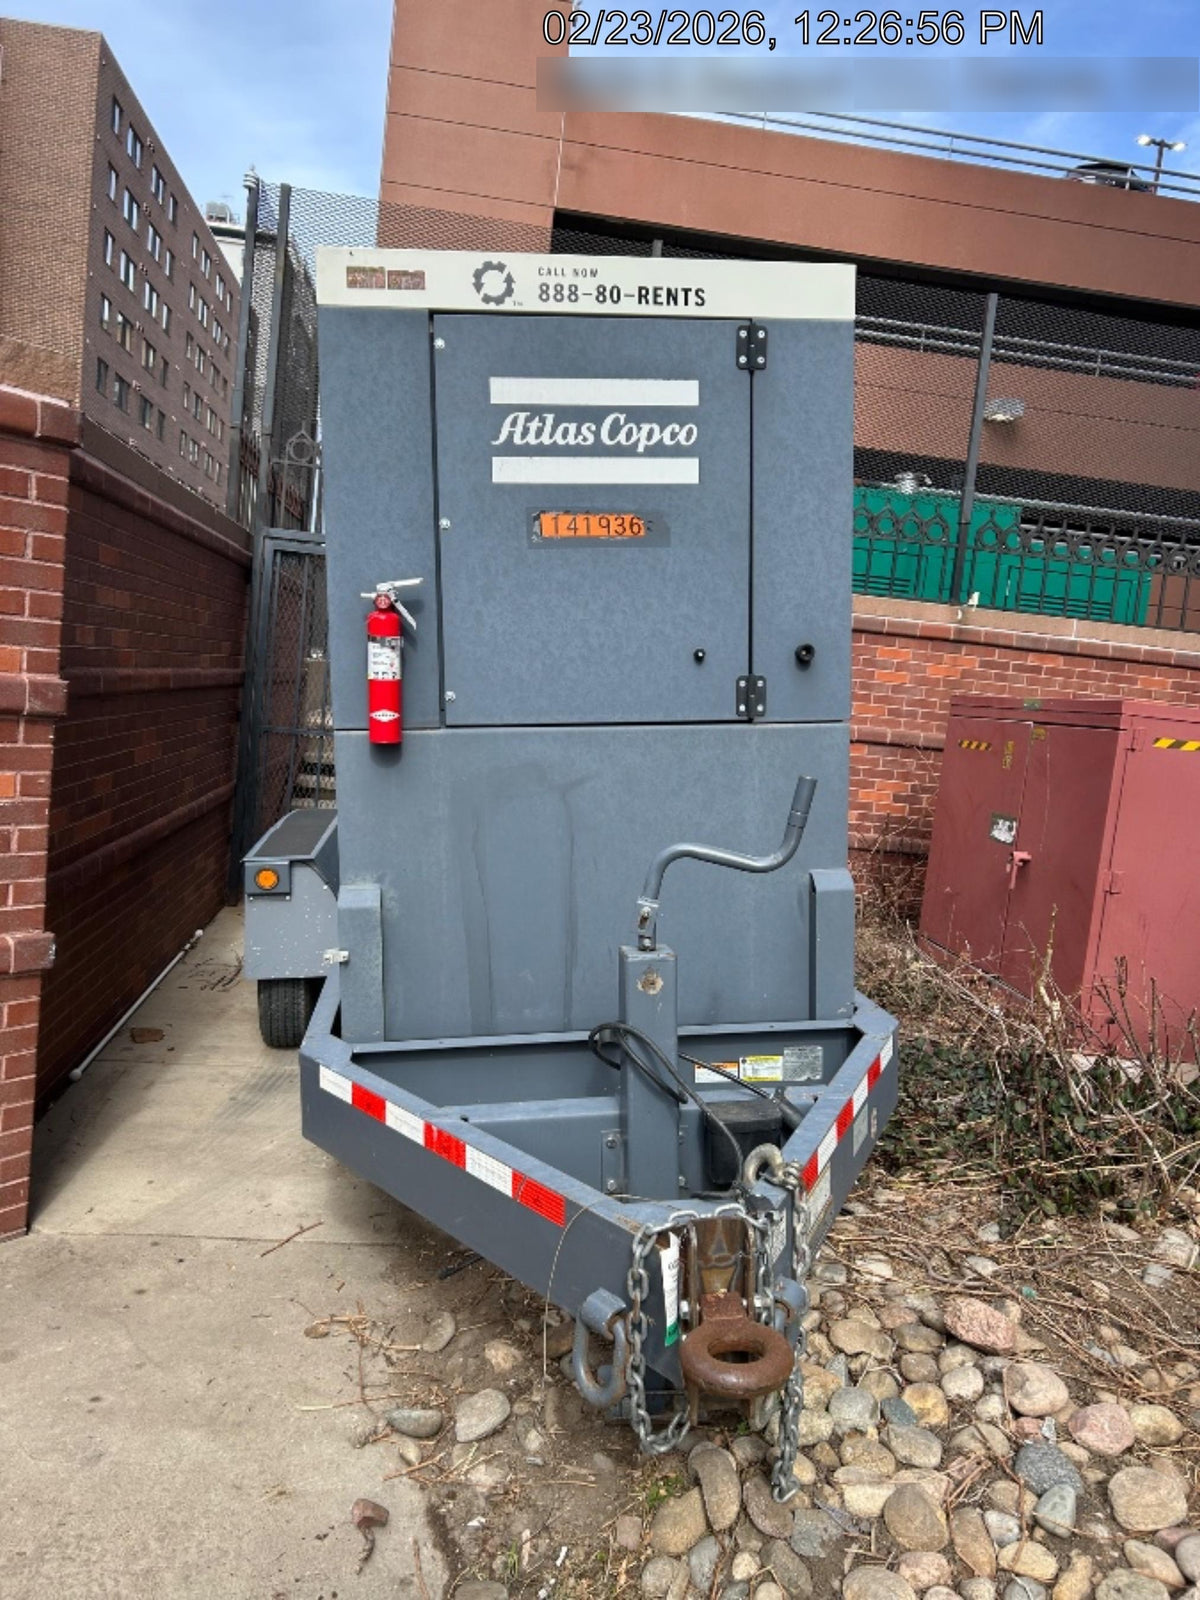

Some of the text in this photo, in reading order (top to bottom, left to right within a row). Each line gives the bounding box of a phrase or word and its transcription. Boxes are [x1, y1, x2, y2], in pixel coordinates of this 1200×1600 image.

[538, 266, 566, 277] CALL
[538, 282, 706, 307] 888-80-RENTS
[491, 411, 698, 452] Atlas Copco
[551, 516, 642, 536] 141936
